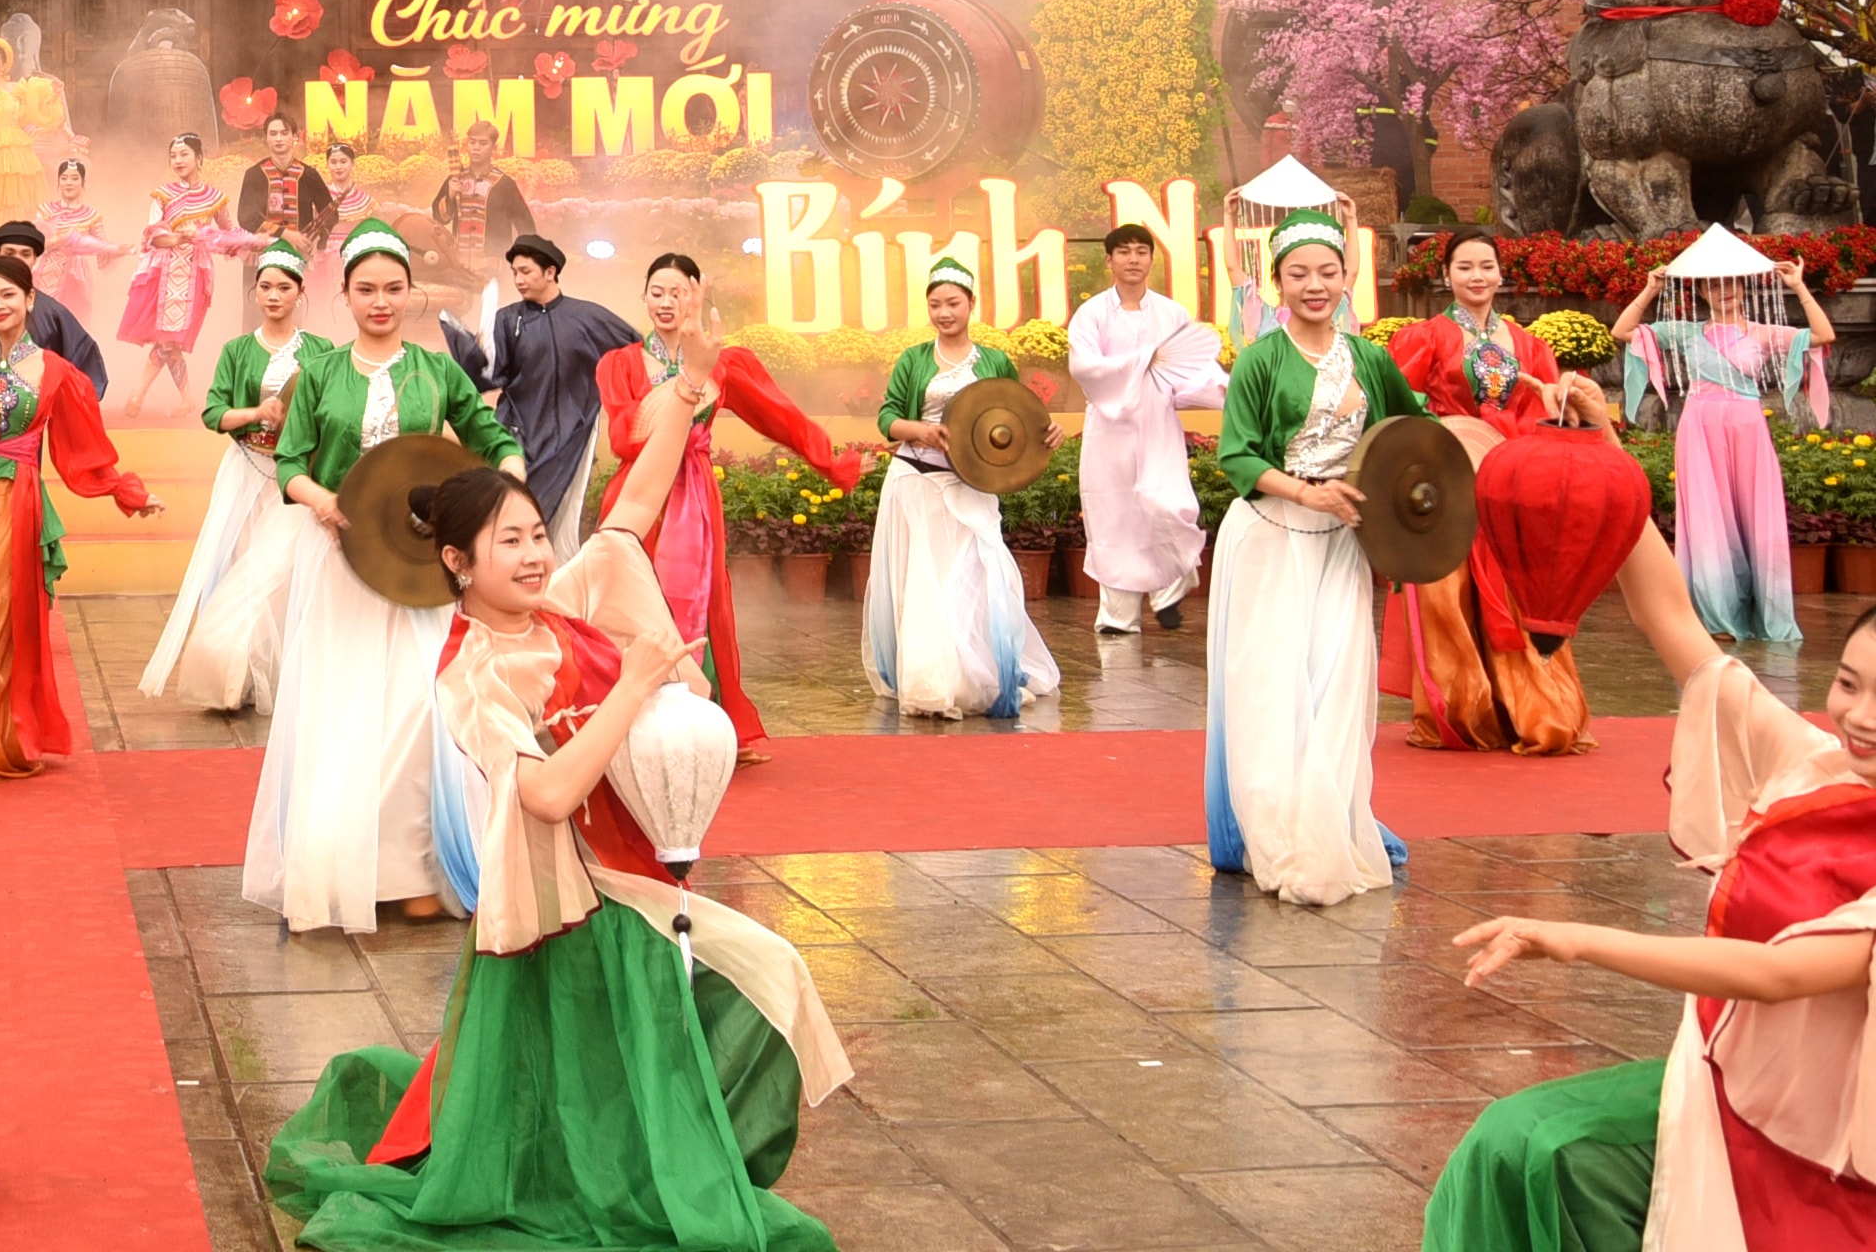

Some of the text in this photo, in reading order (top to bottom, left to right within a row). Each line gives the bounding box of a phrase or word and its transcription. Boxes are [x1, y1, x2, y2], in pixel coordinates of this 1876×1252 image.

[304, 54, 773, 158] NĂM MỚI
[754, 176, 1071, 334] Bính
